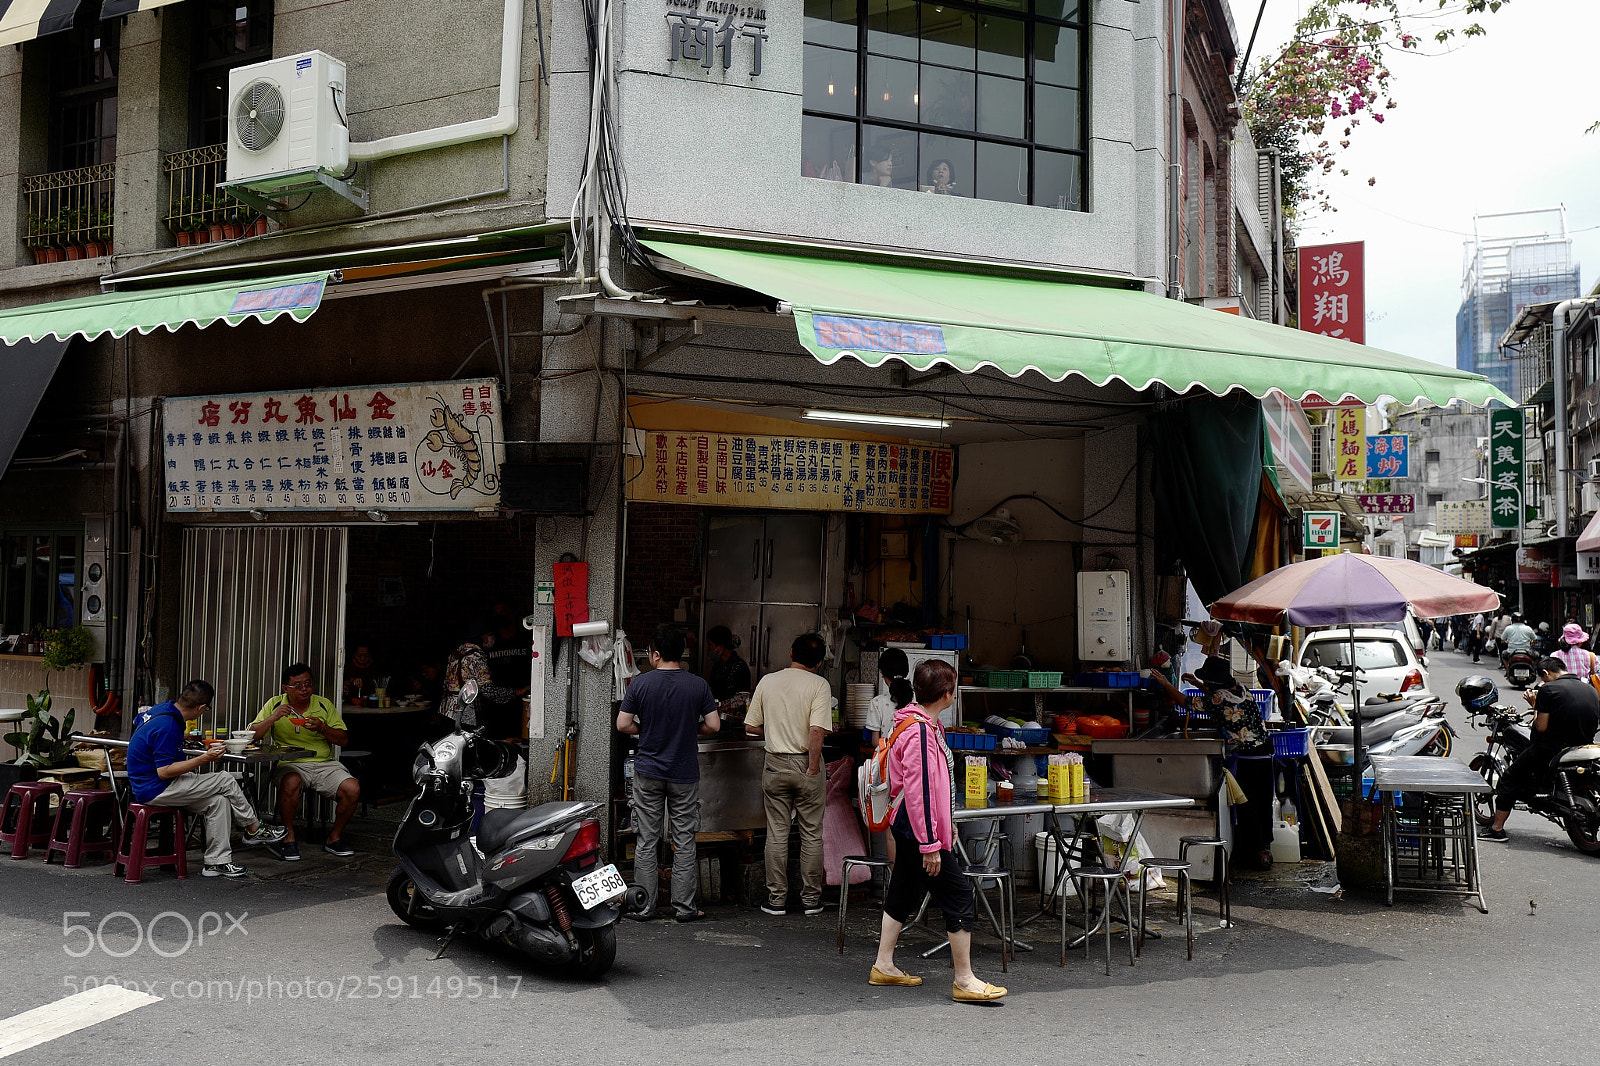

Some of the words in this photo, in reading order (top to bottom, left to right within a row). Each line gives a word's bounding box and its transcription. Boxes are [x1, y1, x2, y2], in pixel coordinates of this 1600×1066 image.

[667, 10, 769, 76] 商行
[1311, 251, 1350, 341] 鴻翔
[198, 390, 396, 426] 金仙魚丸分店
[731, 437, 743, 480] 油豆腐
[745, 438, 756, 480] 魯鴨蛋
[758, 445, 769, 473] 青菜
[771, 439, 781, 480] 炸排骨
[808, 440, 818, 480] 魚丸湯
[820, 442, 830, 481] 蝦仁湯
[225, 431, 239, 492] 魚丸湯
[232, 495, 240, 504] 35
[420, 459, 456, 479] 金仙
[675, 436, 688, 495] 本店特產
[697, 435, 708, 494] 自製自售
[716, 436, 728, 494] 台南口味
[1492, 420, 1521, 517] 天美茗茶
[759, 477, 767, 487] 35
[930, 449, 951, 509] 便當
[734, 482, 742, 492] 10
[747, 482, 755, 493] 15
[772, 483, 779, 493] 45
[785, 483, 793, 492] 45
[798, 483, 804, 492] 45
[809, 484, 817, 492] 35
[822, 485, 828, 493] 45
[834, 485, 840, 494] 45
[169, 496, 177, 507] 20
[184, 496, 190, 505] 35
[199, 496, 205, 506] 15
[214, 496, 221, 506] 45
[249, 494, 256, 503] 45
[266, 494, 272, 503] 45
[284, 494, 290, 502] 45
[302, 494, 310, 502] 30
[319, 494, 326, 503] 60
[338, 494, 346, 503] 90
[356, 493, 364, 503] 95
[376, 493, 384, 503] 90
[389, 492, 397, 502] 95
[401, 492, 411, 503] 10
[1312, 518, 1330, 529] 7
[489, 648, 527, 659] NATIONALS
